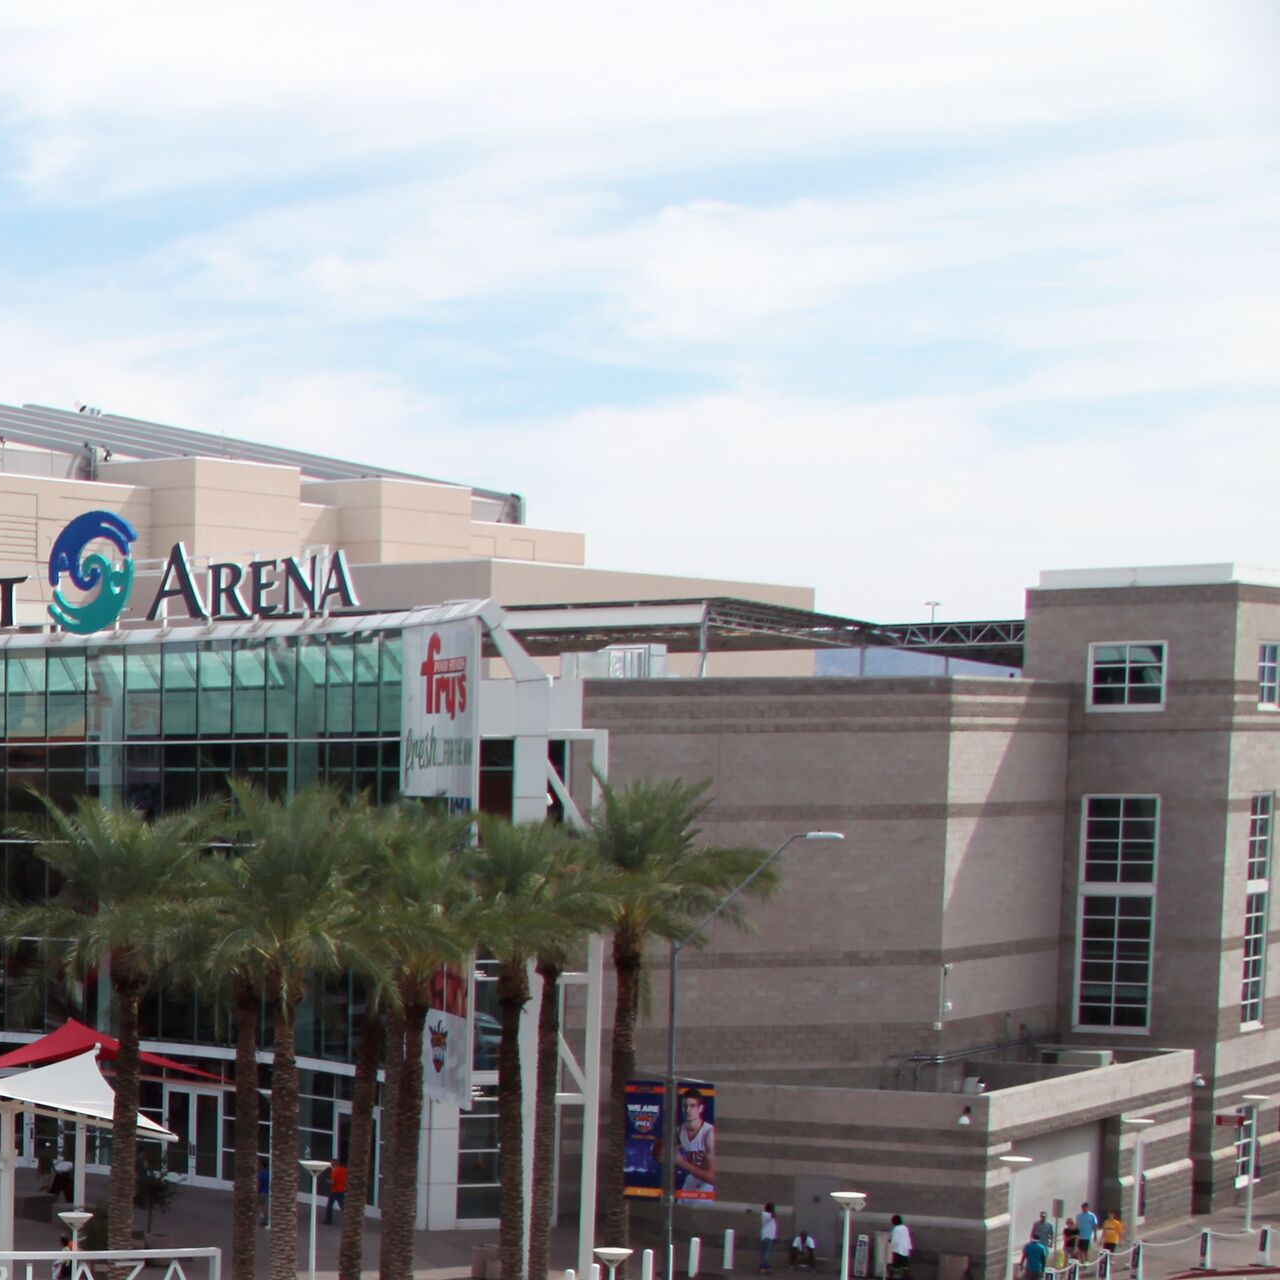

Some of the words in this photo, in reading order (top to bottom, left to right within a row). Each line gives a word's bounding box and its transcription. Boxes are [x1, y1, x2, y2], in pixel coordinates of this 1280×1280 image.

[147, 542, 361, 621] ARENA
[627, 1104, 641, 1112] WE
[642, 1104, 659, 1112] ARE
